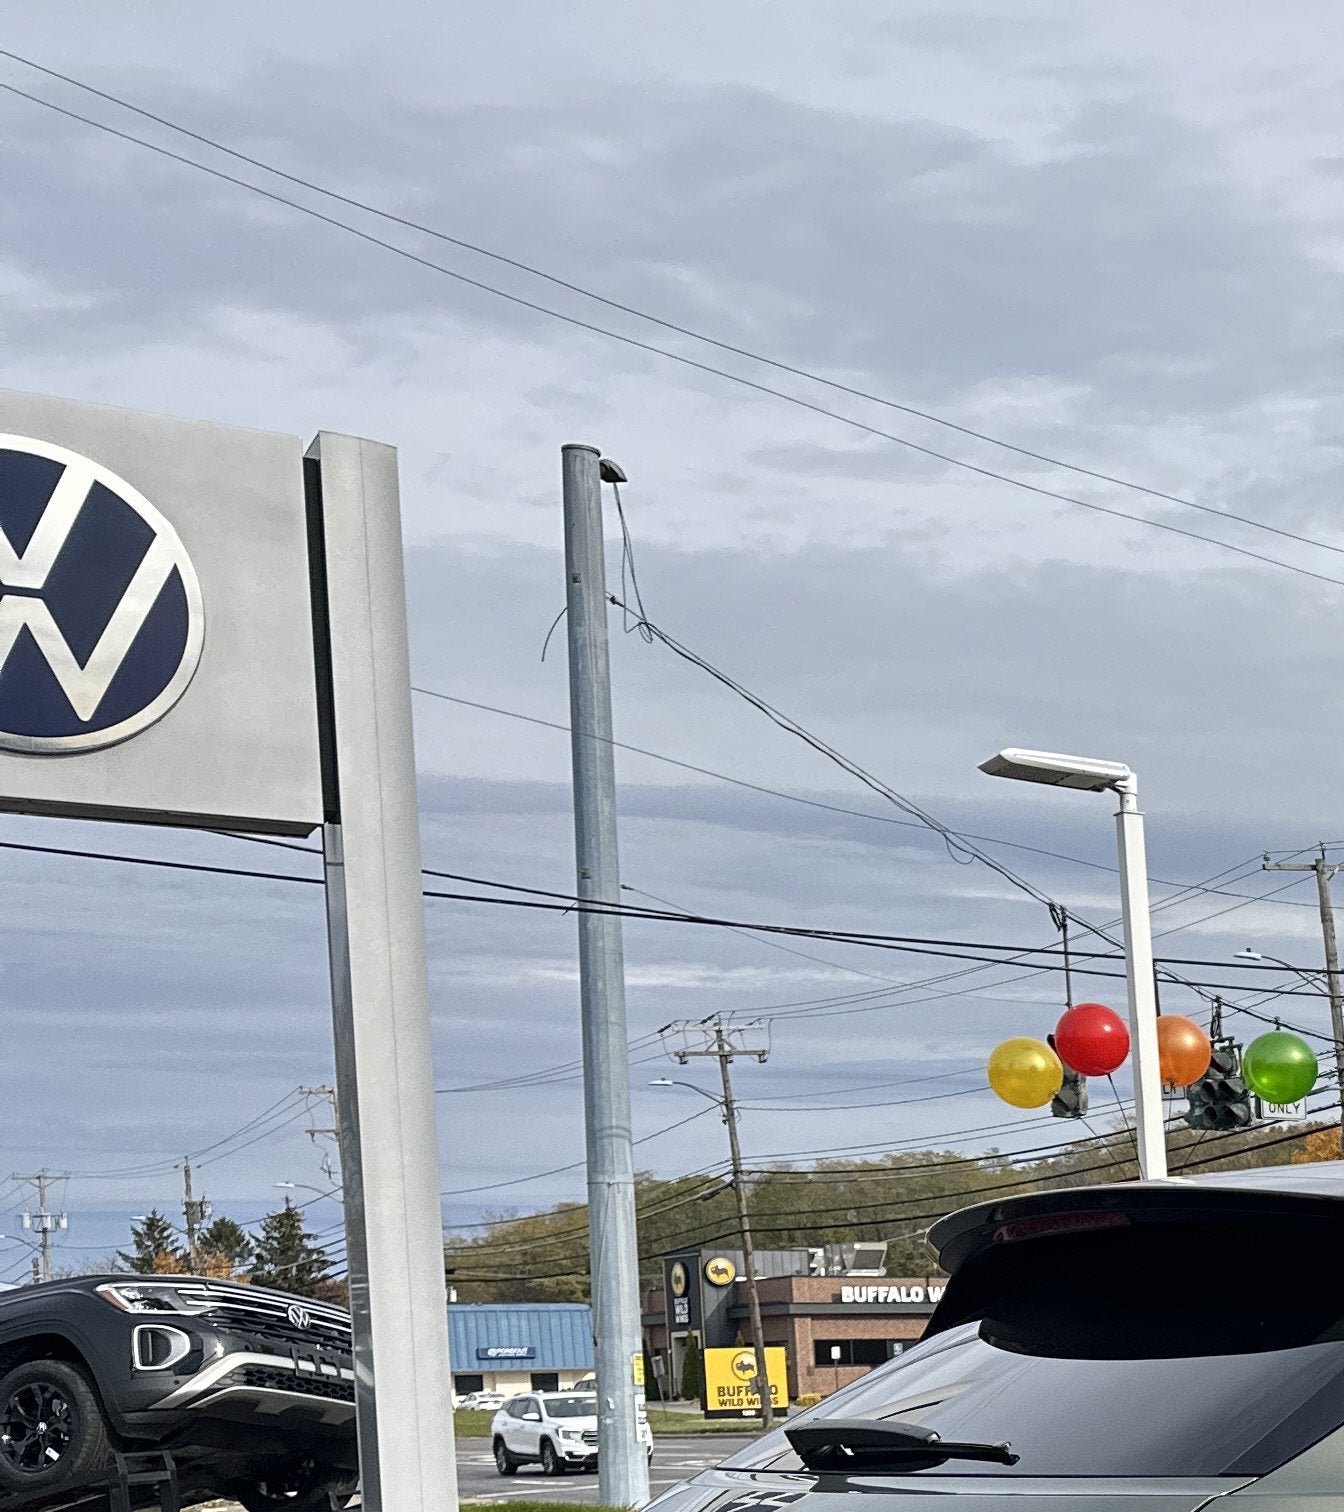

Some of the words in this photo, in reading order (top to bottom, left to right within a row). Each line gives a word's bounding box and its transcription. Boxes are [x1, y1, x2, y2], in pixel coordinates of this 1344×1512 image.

[1268, 1102, 1301, 1115] ONLY
[841, 1286, 924, 1303] BUFFALO
[717, 1385, 778, 1397] BUFFO
[718, 1398, 744, 1407] WILD
[746, 1397, 778, 1407] WIS
